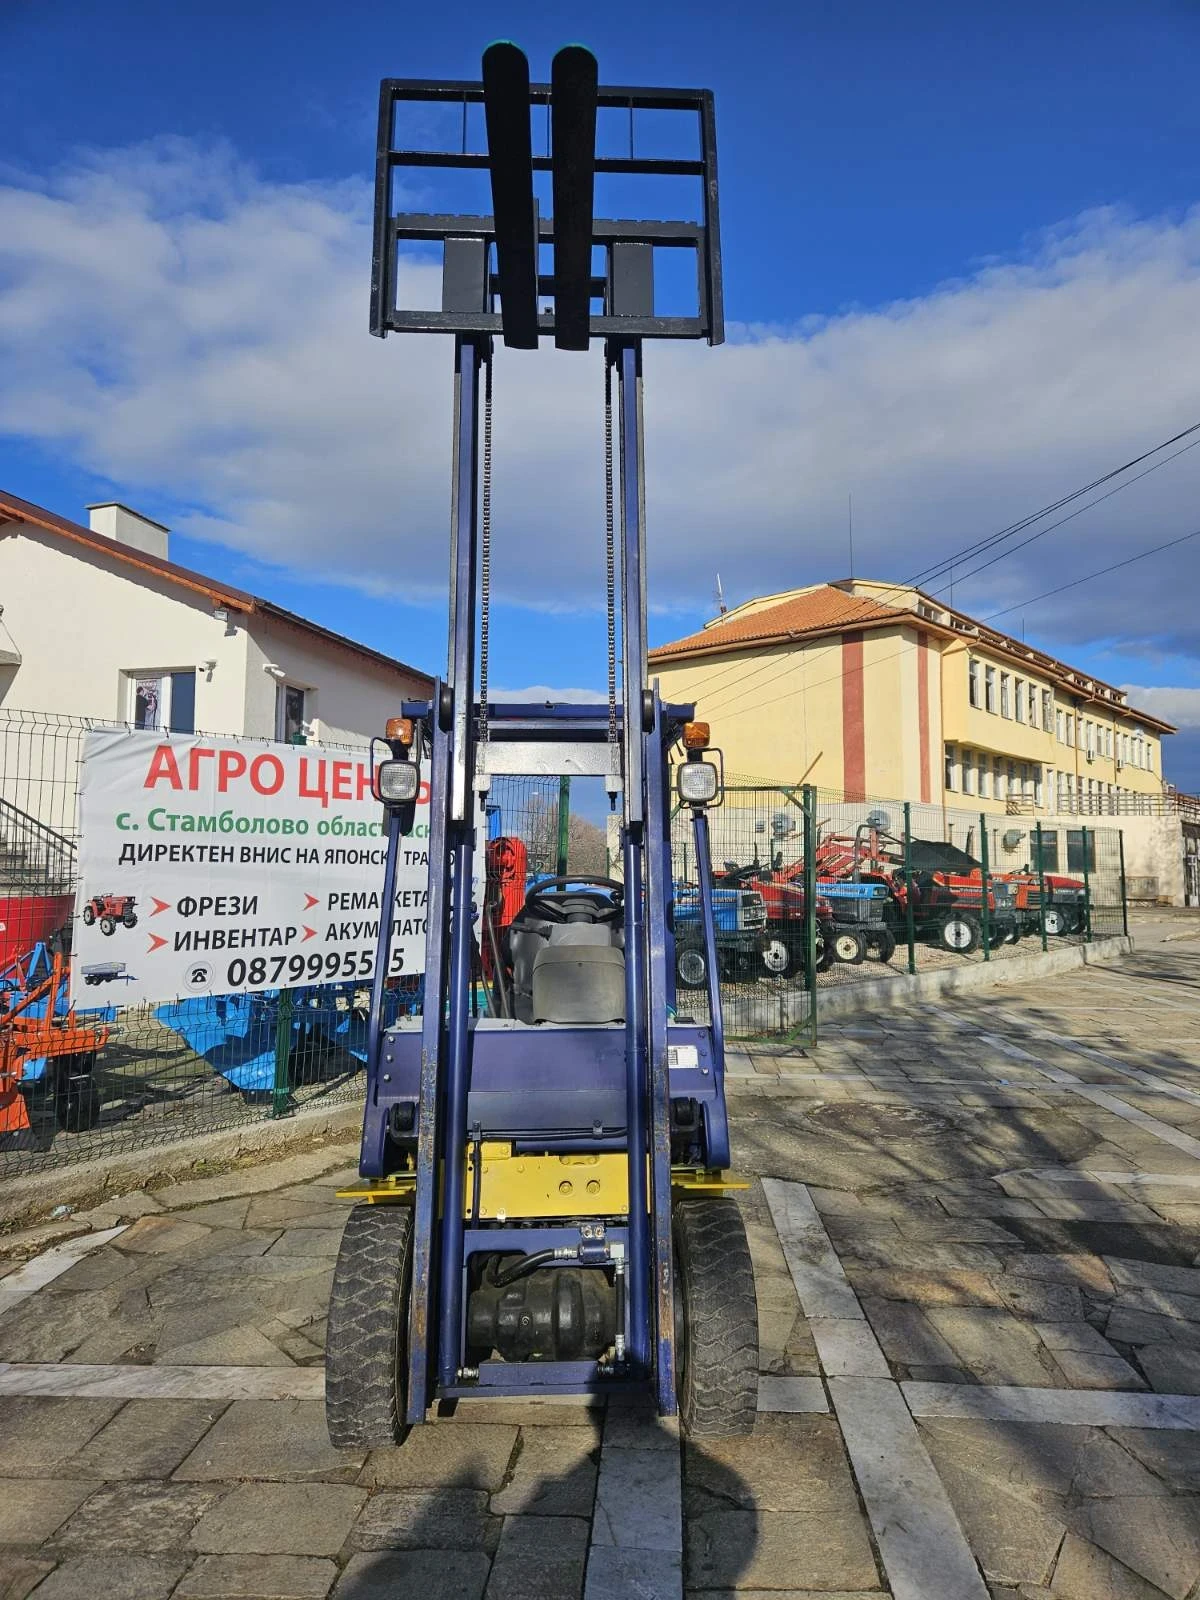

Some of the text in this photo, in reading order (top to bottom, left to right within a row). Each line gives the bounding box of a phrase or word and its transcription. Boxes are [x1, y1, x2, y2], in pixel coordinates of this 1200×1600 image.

[143, 744, 285, 796] АГРО
[116, 812, 139, 831] с.
[148, 808, 309, 835] Стамболово
[118, 843, 234, 866] ДИРЕКТЕН
[240, 846, 292, 864] ВНИС
[296, 848, 320, 864] НА
[324, 849, 388, 865] ЯПОНСК
[177, 895, 258, 918] ФРЕЗИ
[328, 890, 428, 911] РЕМАКЕТА
[174, 926, 297, 952] ИНВЕНТАР
[227, 948, 404, 987] 087999555
